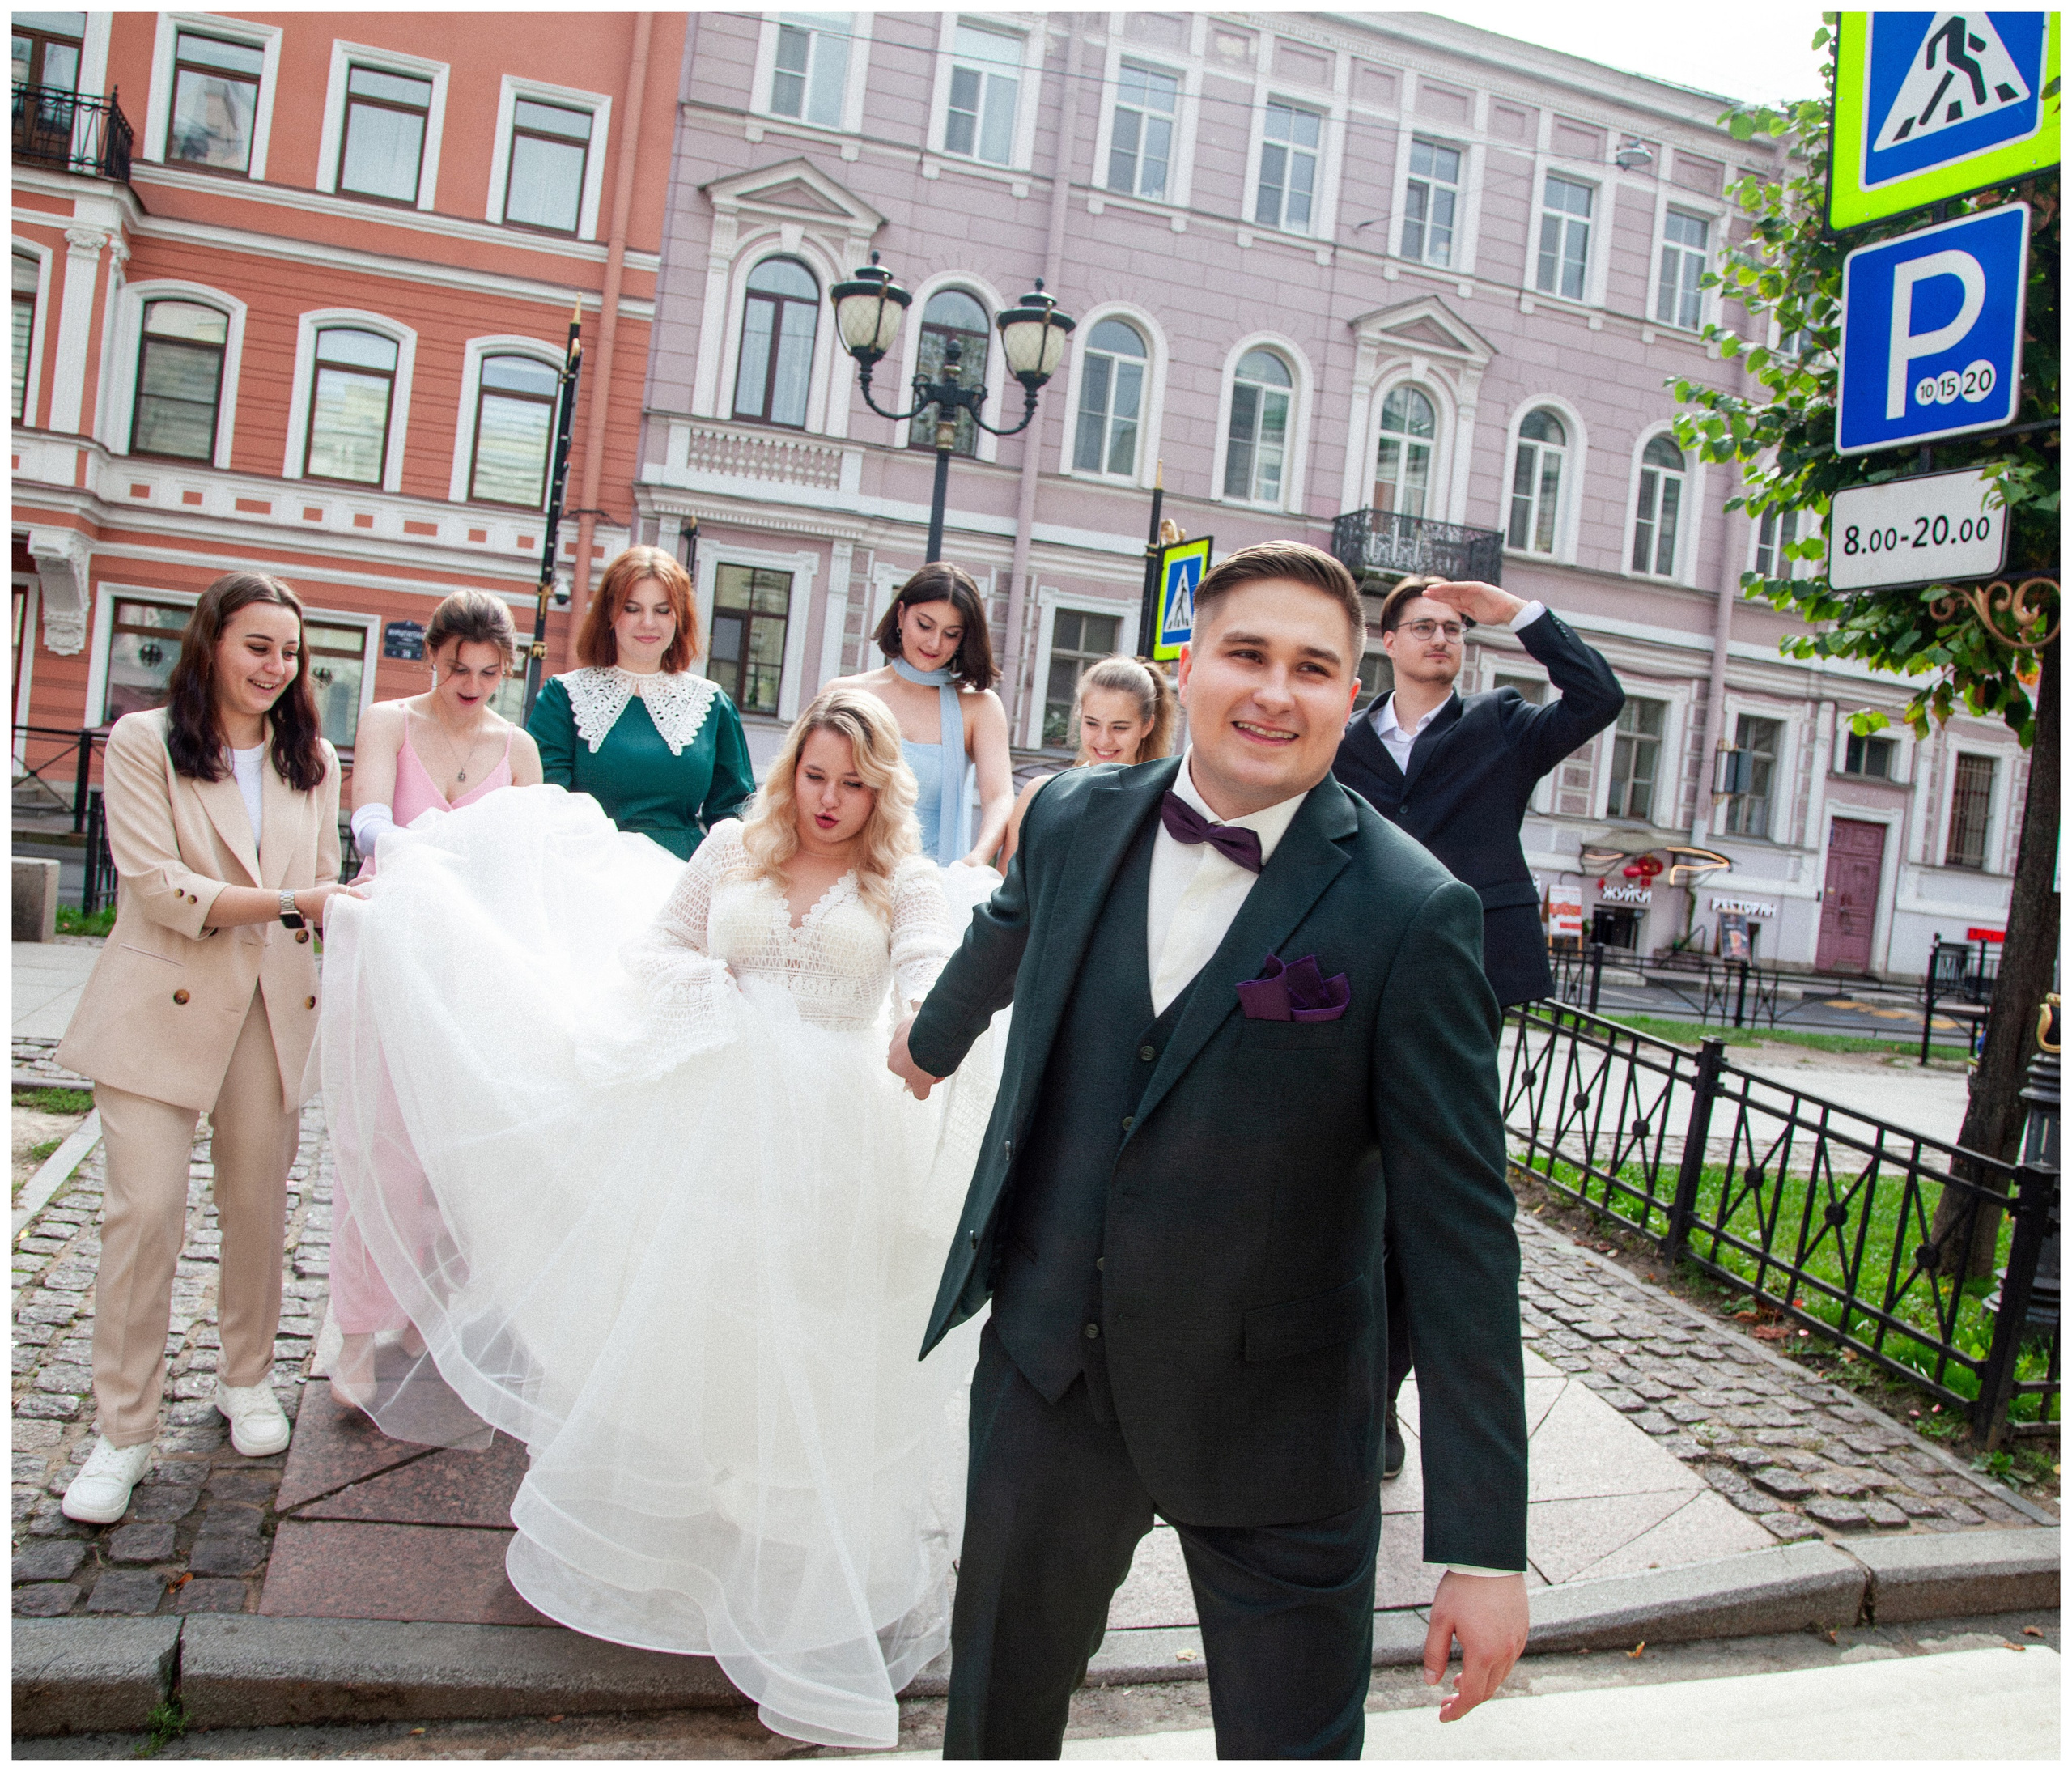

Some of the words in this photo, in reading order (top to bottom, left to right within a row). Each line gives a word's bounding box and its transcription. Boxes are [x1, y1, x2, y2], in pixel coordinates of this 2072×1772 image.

[1886, 249, 1986, 420] P
[1921, 384, 1934, 399] 10
[1940, 377, 1955, 397] 15
[1964, 368, 1992, 395] 20
[1844, 515, 1990, 555] 8.00-20.00
[1710, 897, 1777, 918] РЕСТОРАН
